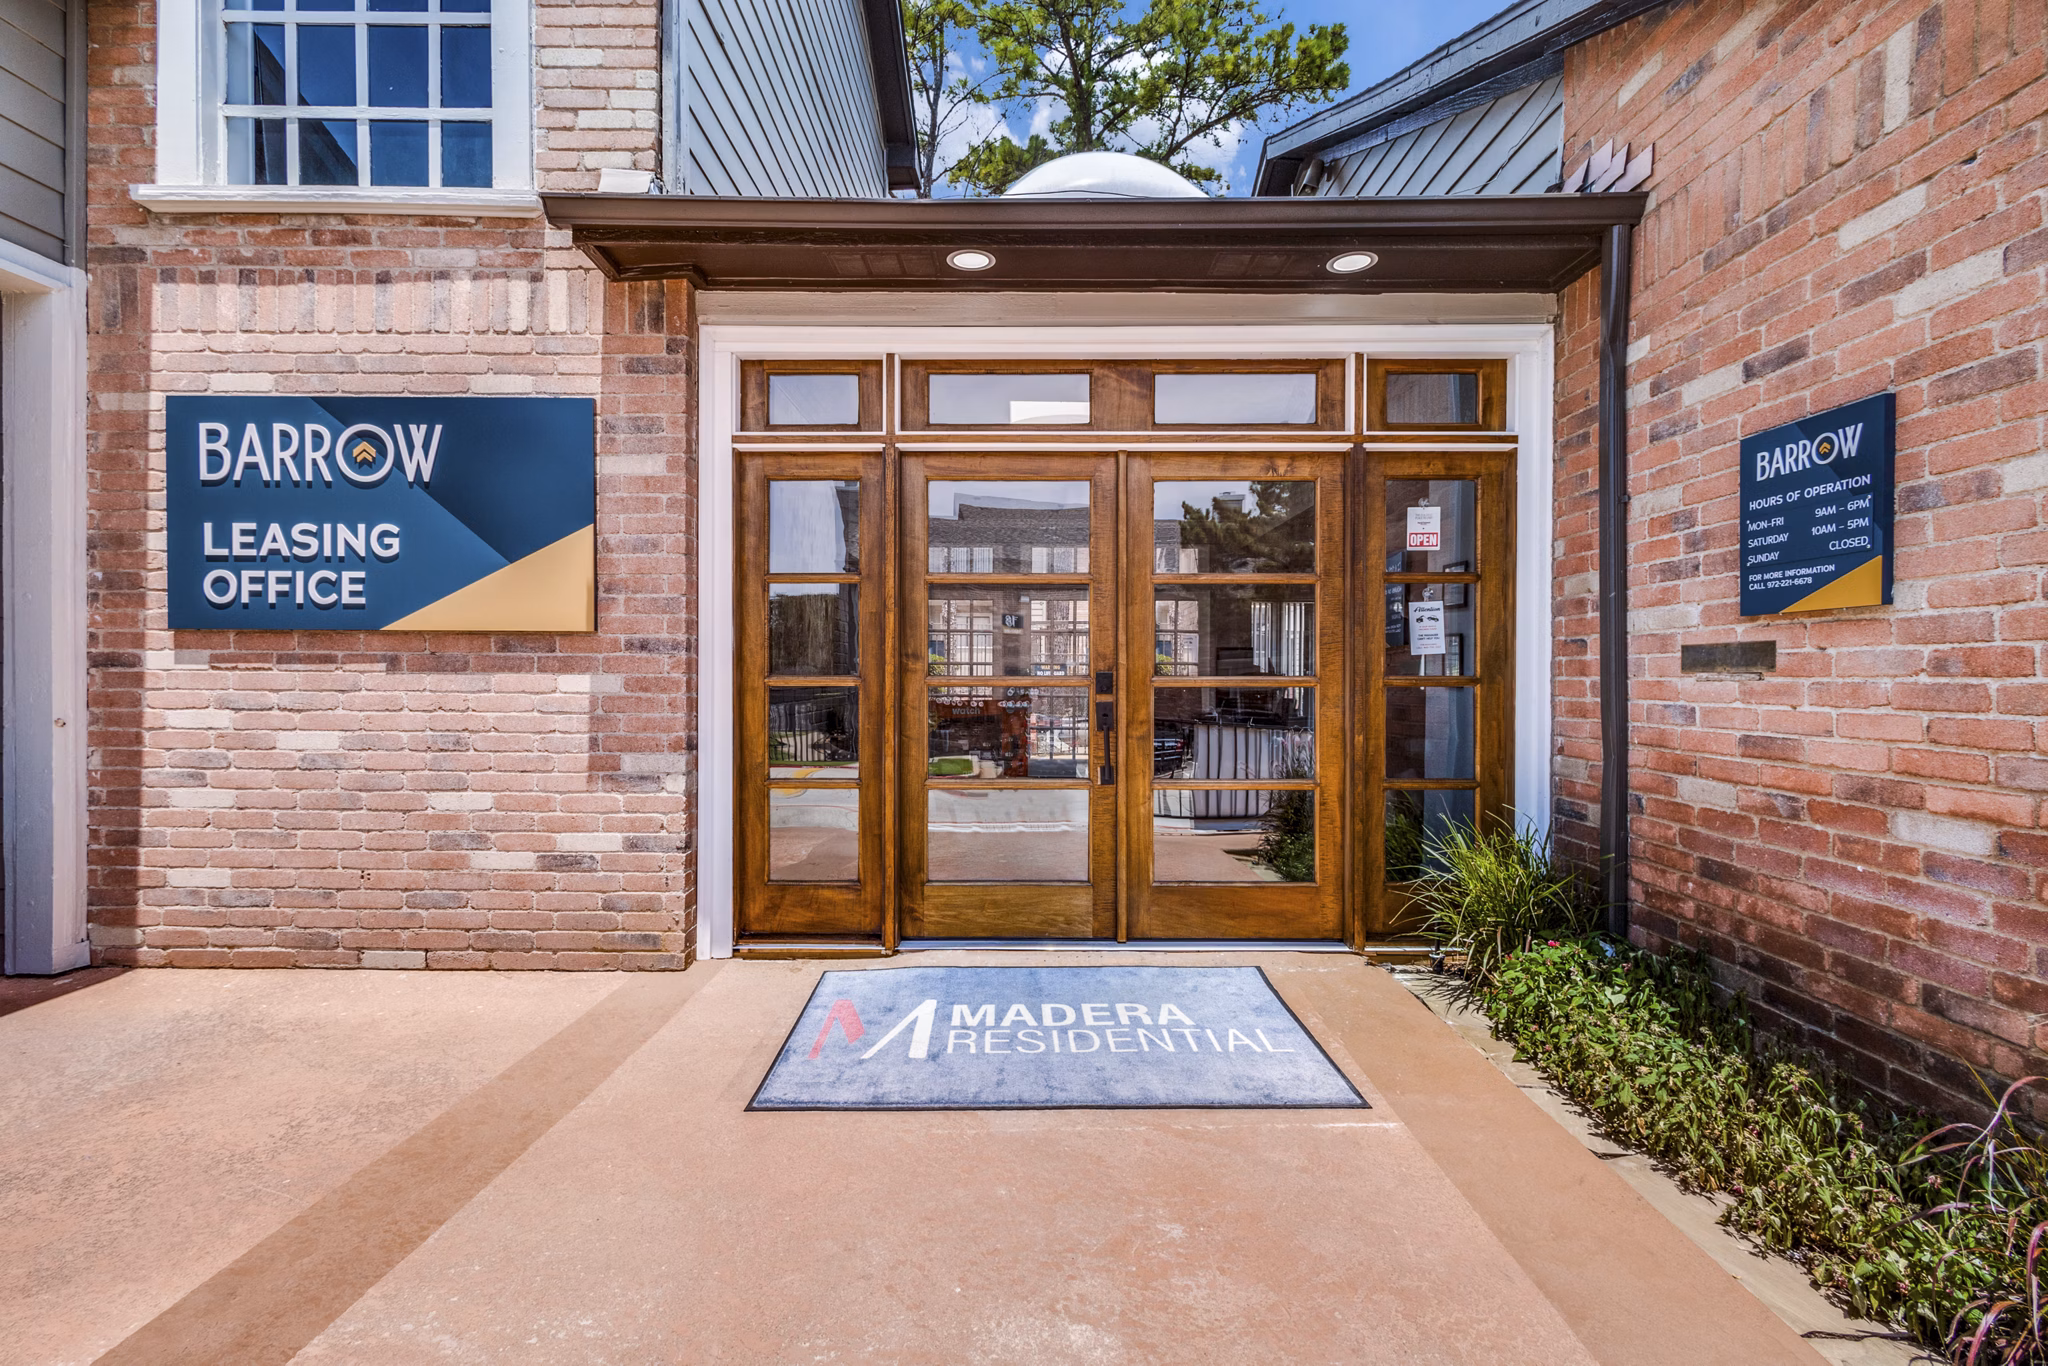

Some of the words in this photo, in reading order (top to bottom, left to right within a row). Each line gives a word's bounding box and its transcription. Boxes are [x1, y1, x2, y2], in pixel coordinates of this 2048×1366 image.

[199, 422, 443, 483] BARROW
[1756, 423, 1864, 482] BARROW
[1749, 494, 1783, 511] HOURS
[1786, 490, 1801, 503] OF
[1804, 474, 1871, 498] OPERATION
[1815, 505, 1836, 518] 9AM
[1847, 499, 1870, 511] 6PM
[203, 522, 400, 558] LEASING
[1410, 534, 1437, 546] OPEN
[1748, 533, 1789, 548] SATURDAY
[1811, 523, 1836, 536] 10AM
[1847, 517, 1869, 530] 5PM
[1748, 551, 1780, 564] SUNDAY
[1829, 536, 1869, 551] CLOSED
[1749, 574, 1762, 582] FOR
[1763, 571, 1783, 580] MORE
[1784, 564, 1836, 577] INFORMATION
[203, 569, 366, 605] OFFICE
[1749, 583, 1765, 591] CALL
[952, 707, 981, 715] watch
[950, 1003, 1196, 1027] MADERA
[946, 1028, 1295, 1055] RESIDENTIAL
